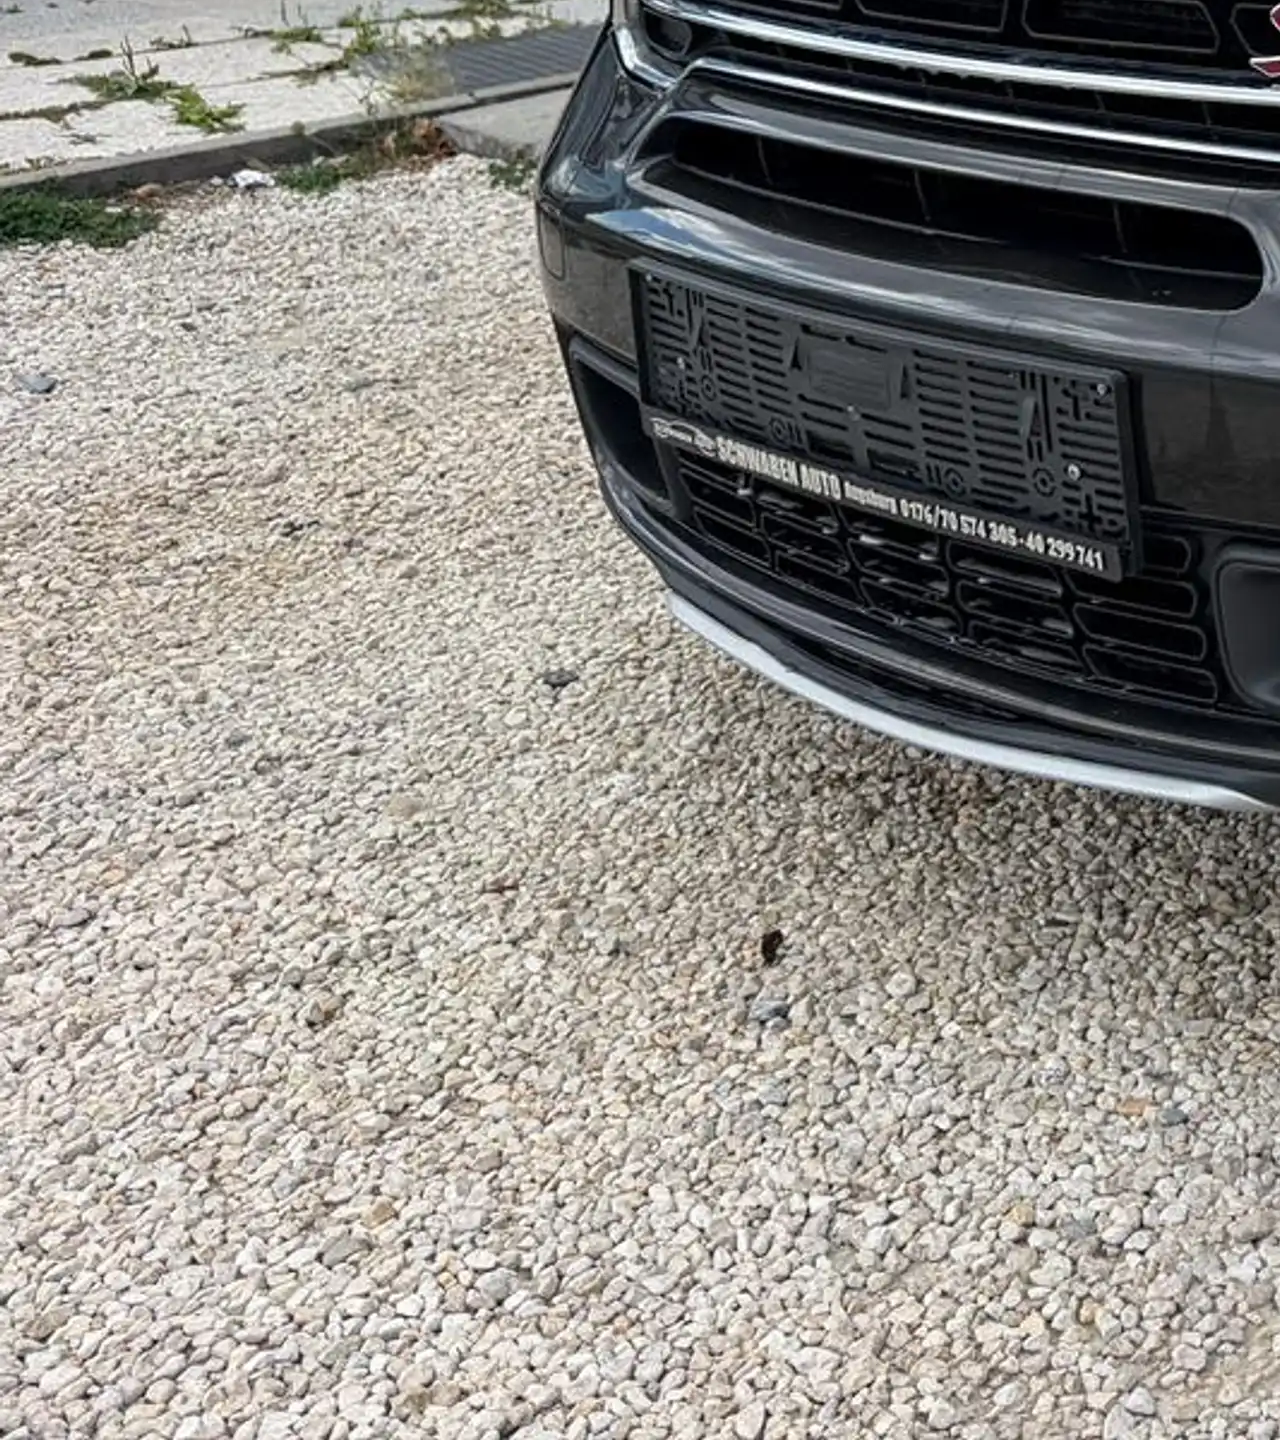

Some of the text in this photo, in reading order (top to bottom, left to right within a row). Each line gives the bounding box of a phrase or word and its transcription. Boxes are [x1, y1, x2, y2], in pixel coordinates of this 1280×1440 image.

[716, 436, 799, 486] SCHWABEN
[800, 463, 842, 501] AUTO
[960, 513, 987, 539] 574
